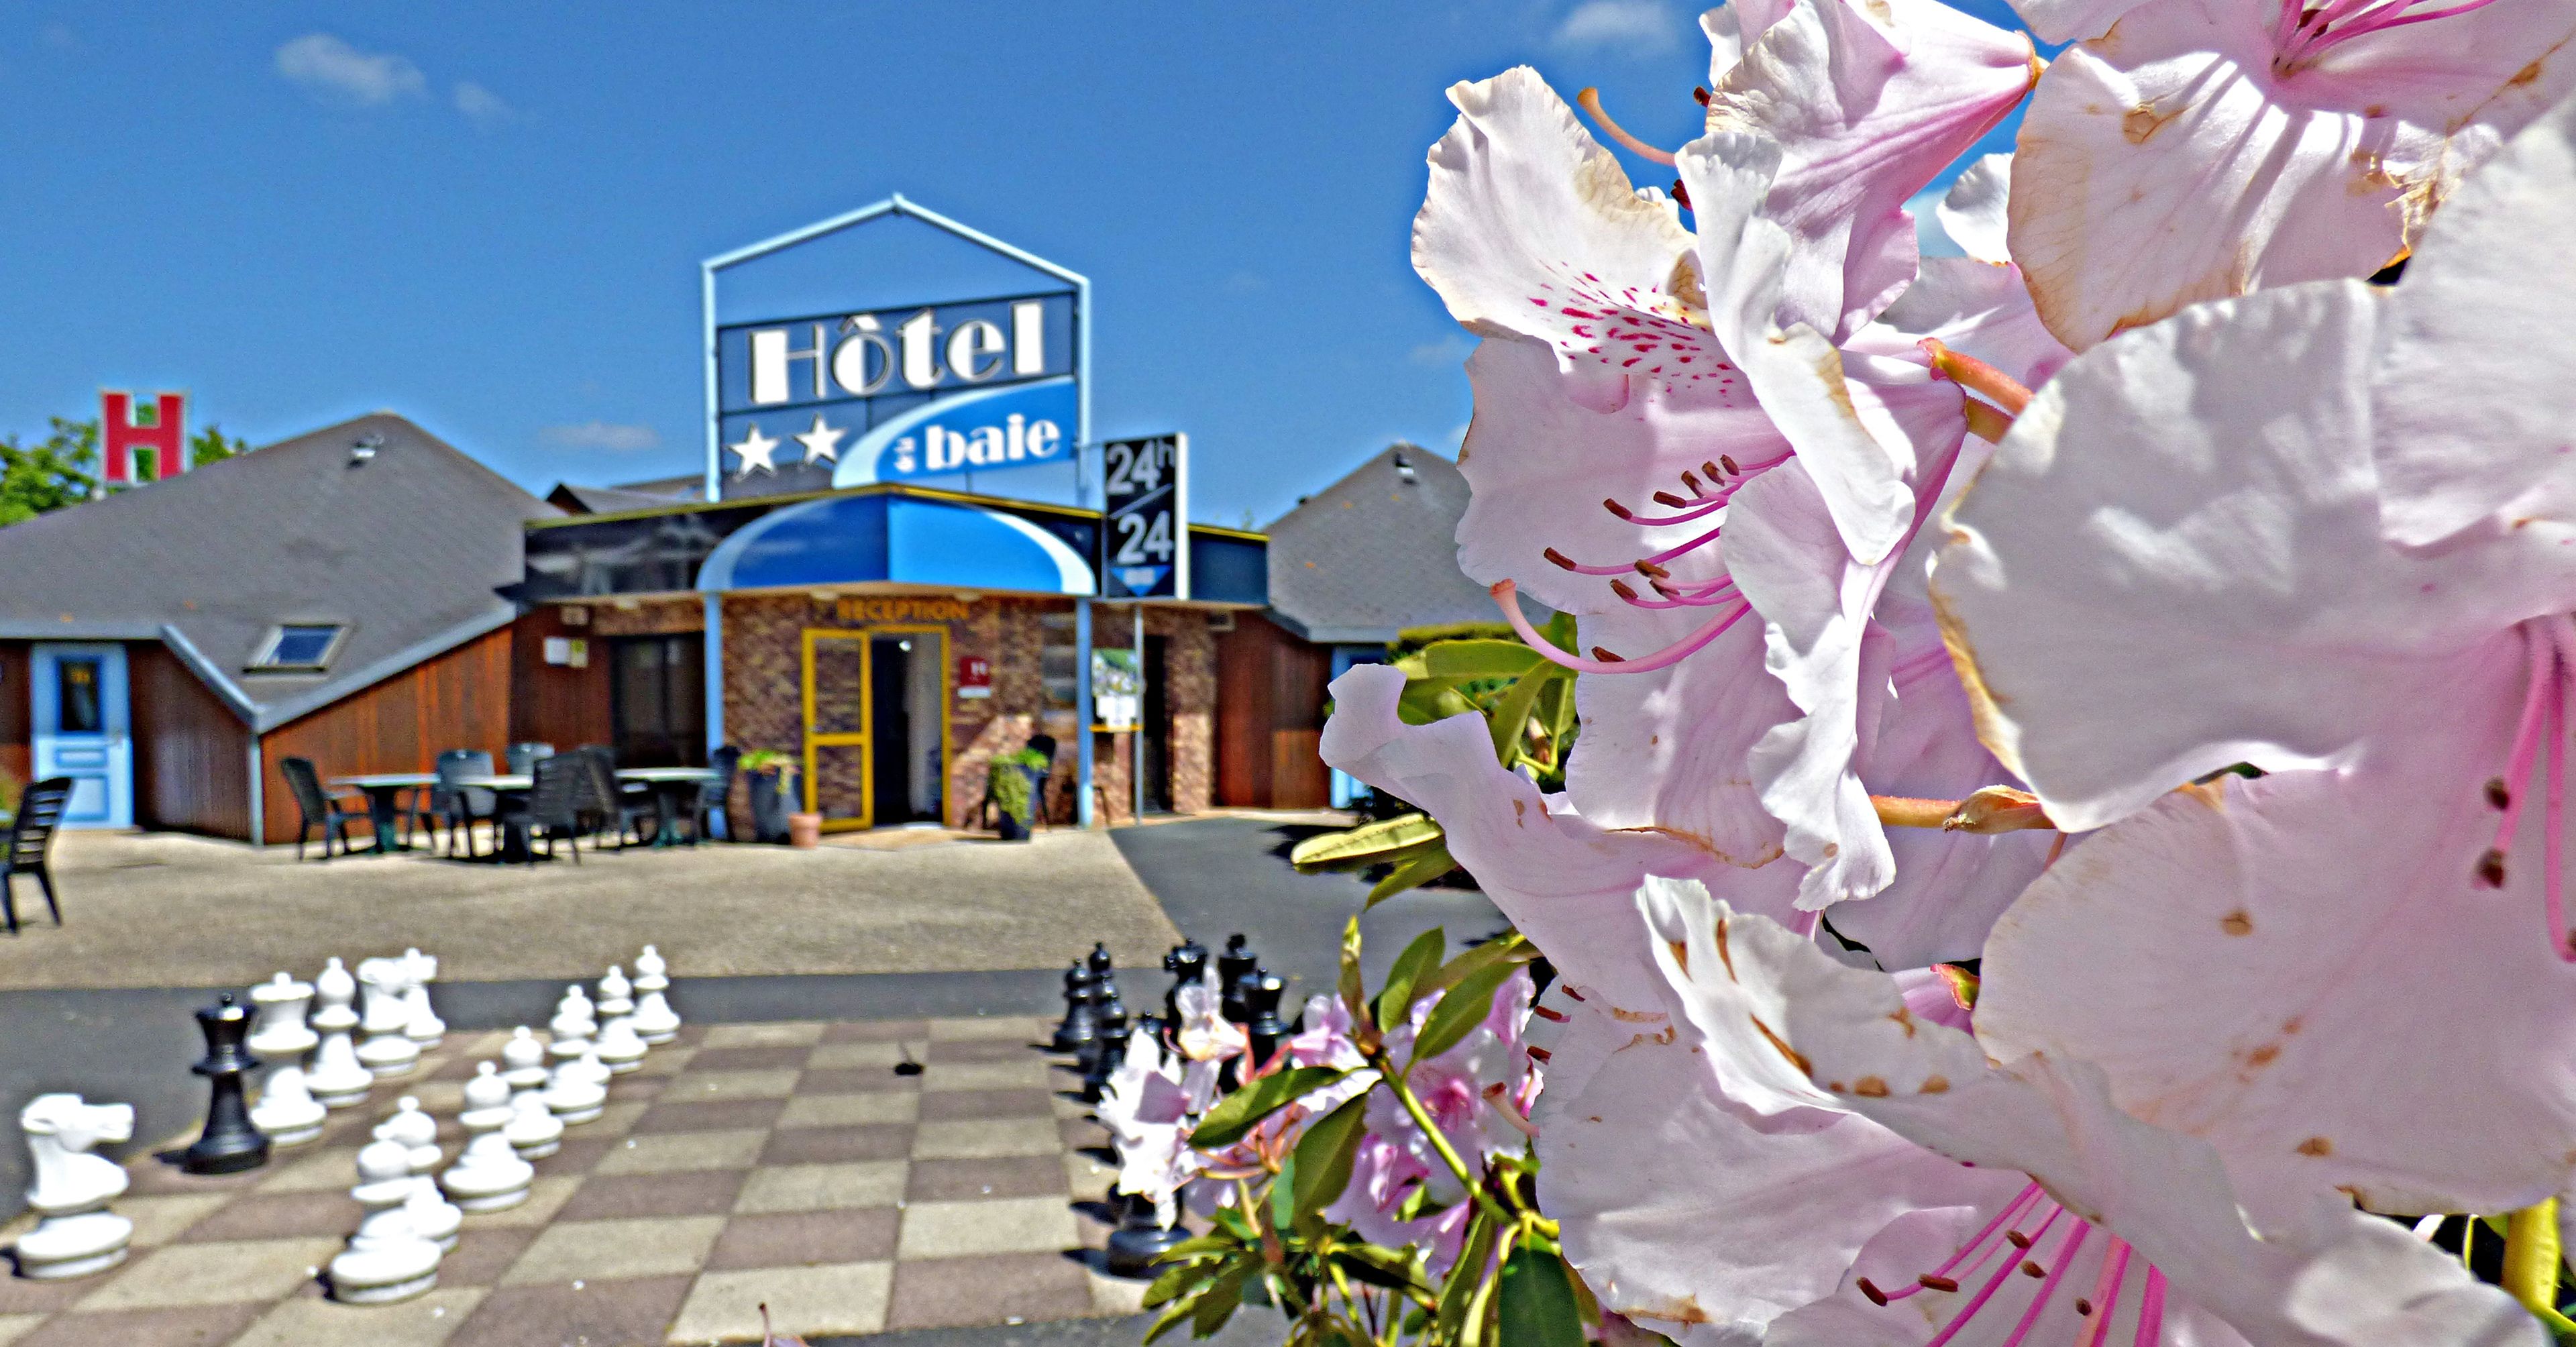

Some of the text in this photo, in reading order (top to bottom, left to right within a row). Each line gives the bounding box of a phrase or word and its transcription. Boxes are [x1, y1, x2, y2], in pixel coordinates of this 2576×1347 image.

[749, 301, 1044, 405] Hôtel
[102, 390, 186, 483] H
[925, 413, 1061, 470] baie
[1106, 439, 1175, 495] 24h
[1116, 510, 1174, 564] 24
